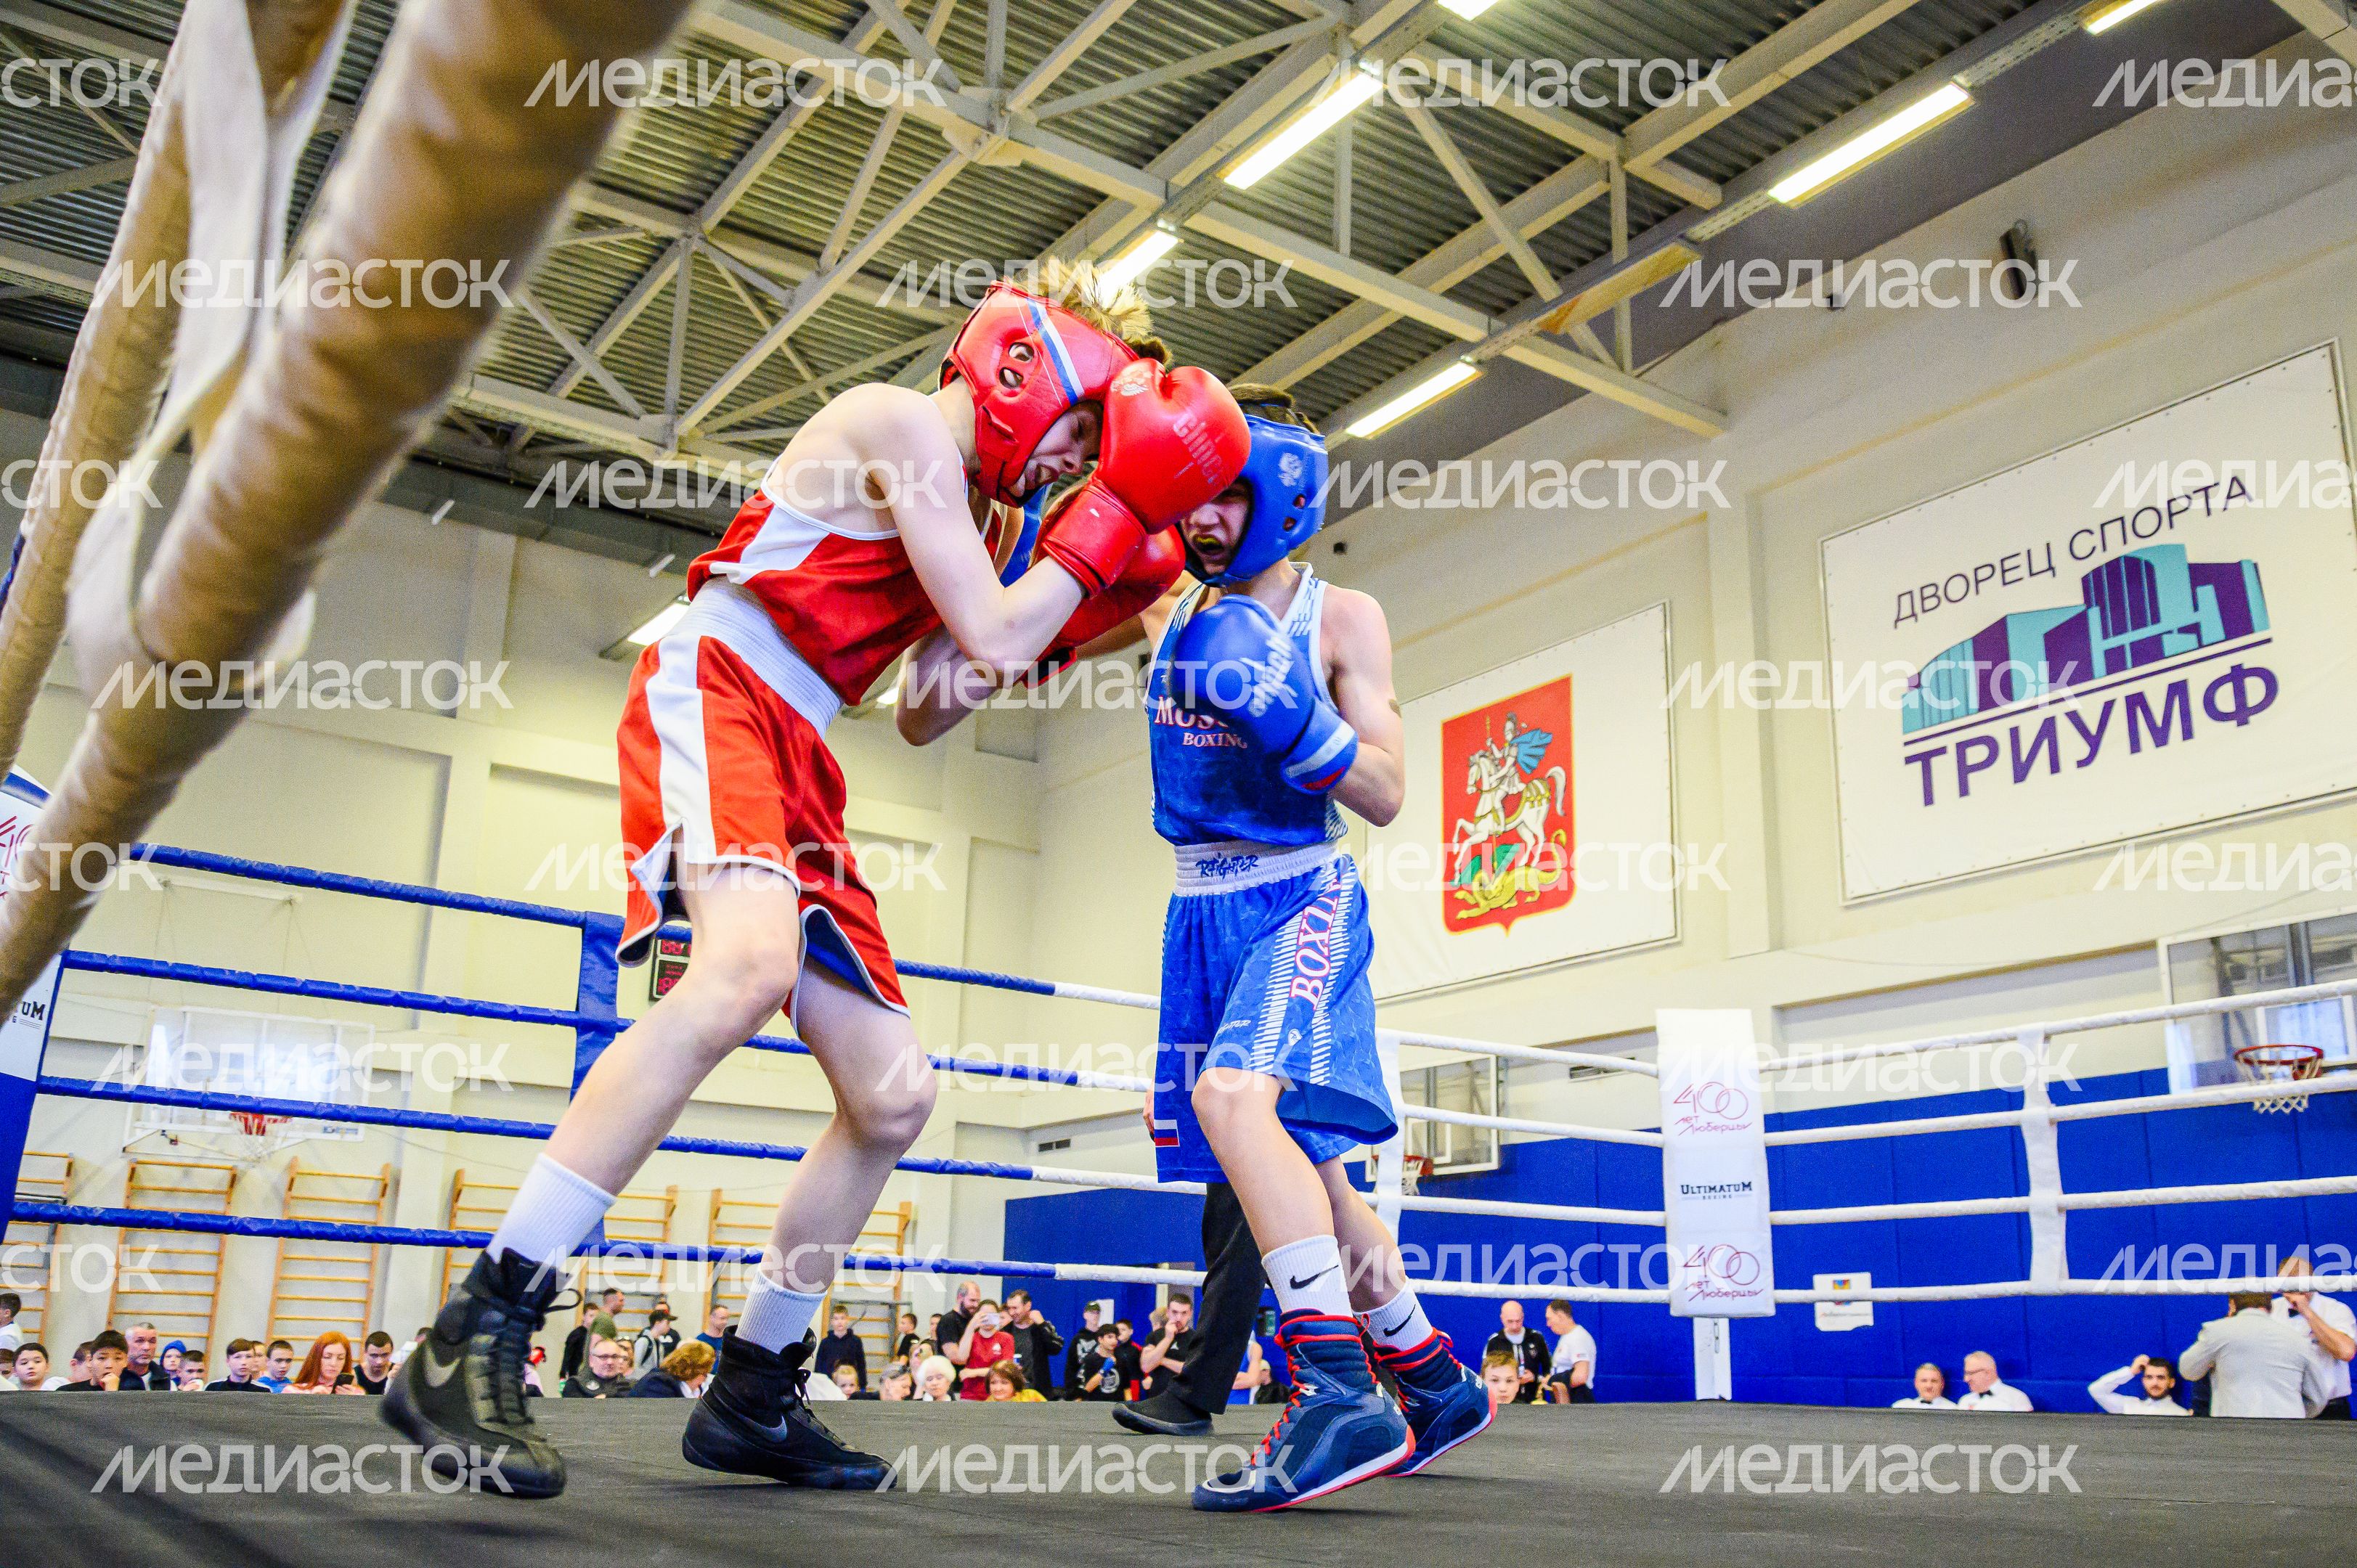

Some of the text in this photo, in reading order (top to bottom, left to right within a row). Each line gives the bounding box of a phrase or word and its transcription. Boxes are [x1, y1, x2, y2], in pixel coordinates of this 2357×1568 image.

[1894, 475, 2253, 629] ДВОРЕЦ СПОРТА
[1904, 663, 2279, 807] ТРИУМФ
